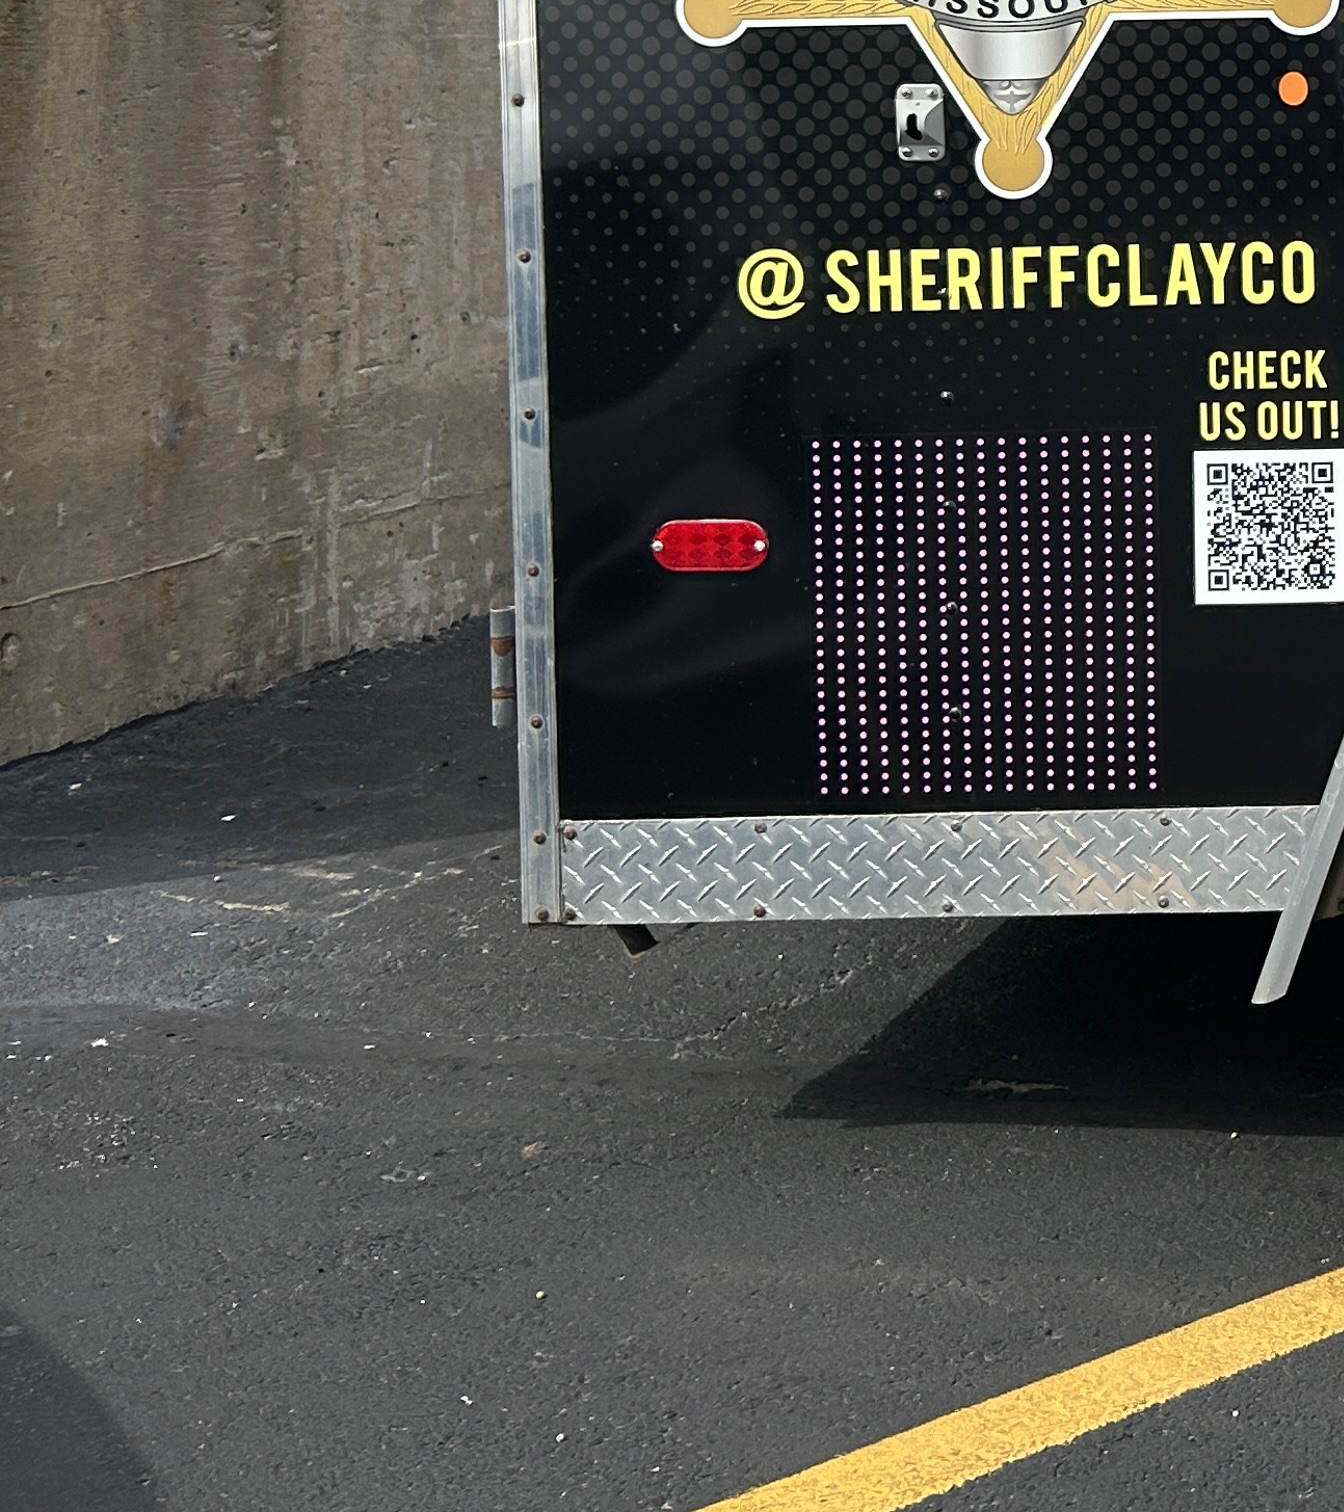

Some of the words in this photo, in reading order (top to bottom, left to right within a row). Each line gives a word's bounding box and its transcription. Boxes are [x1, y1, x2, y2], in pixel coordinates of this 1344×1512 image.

[737, 248, 806, 320] @
[825, 239, 1317, 315] SHERIFFCLAYCO
[1208, 349, 1328, 390] CHECK
[1200, 402, 1247, 442] US
[1256, 398, 1340, 441] OUT!
